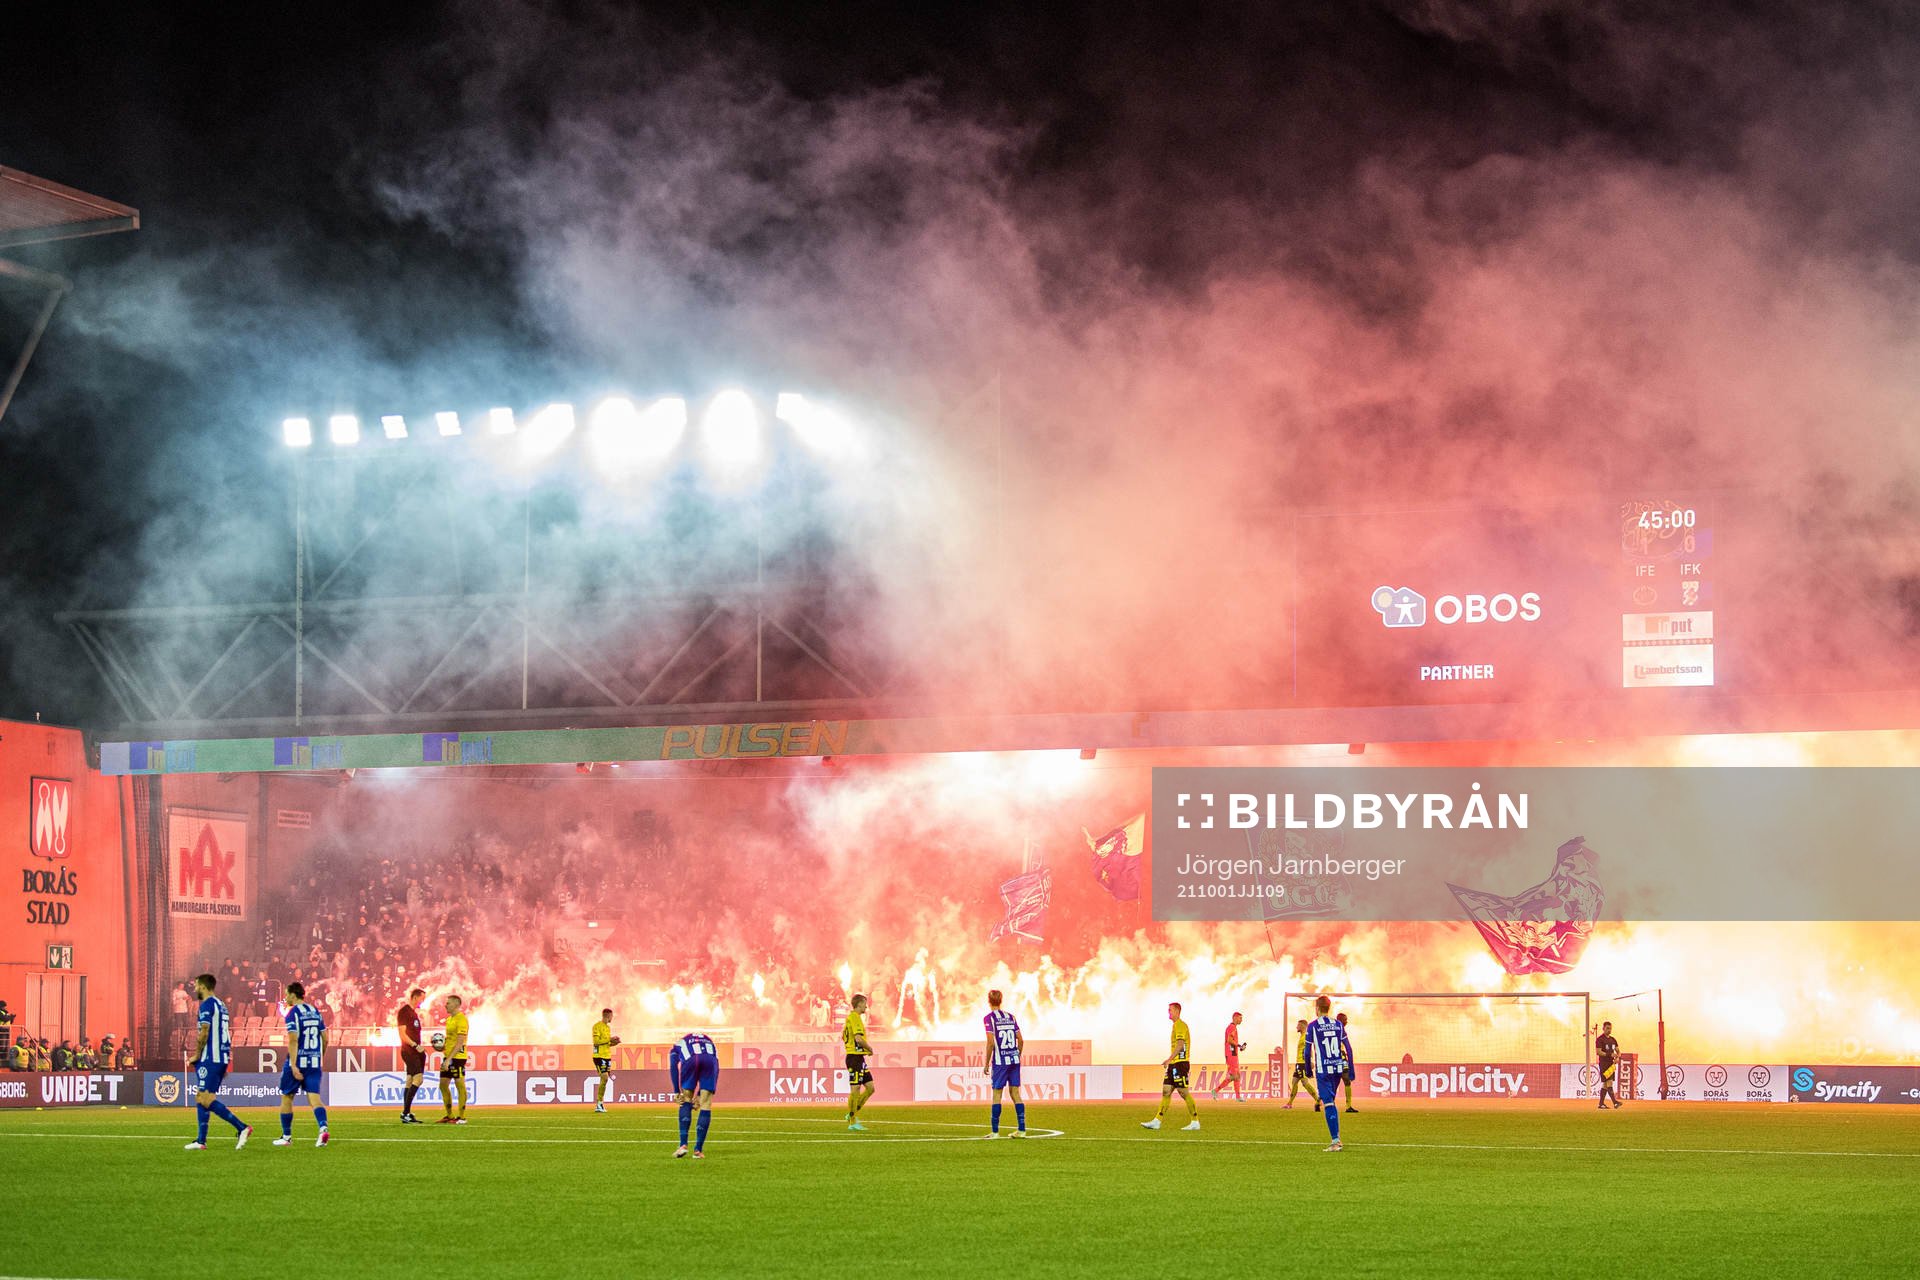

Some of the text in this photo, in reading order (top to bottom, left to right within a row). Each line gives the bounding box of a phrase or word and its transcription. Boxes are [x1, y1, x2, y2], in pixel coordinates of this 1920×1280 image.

[1638, 510, 1696, 529] 45:00
[1636, 565, 1655, 577] IFE
[1680, 563, 1701, 575] IFK
[1434, 592, 1541, 624] OBOS
[1421, 664, 1494, 681] PARTNER
[660, 720, 849, 760] PULSEN
[179, 823, 236, 899] MAX
[22, 866, 77, 896] BORÅS
[26, 900, 70, 925] STAD
[171, 901, 209, 914] HAMBURGARE
[217, 903, 242, 916] SVENSKA
[302, 1026, 319, 1050] 13
[998, 1029, 1016, 1049] 29
[1321, 1036, 1340, 1058] 14
[487, 1045, 560, 1071] renta
[41, 1075, 125, 1103] UNIBET
[769, 1069, 828, 1095] kvik
[1270, 1059, 1282, 1098] SELECT
[1369, 1066, 1529, 1098] Simplicity.
[1619, 1059, 1631, 1099] SELECT
[1703, 1087, 1729, 1097] BORÅS
[1746, 1088, 1772, 1098] BORÅS
[1814, 1081, 1882, 1102] Syncify
